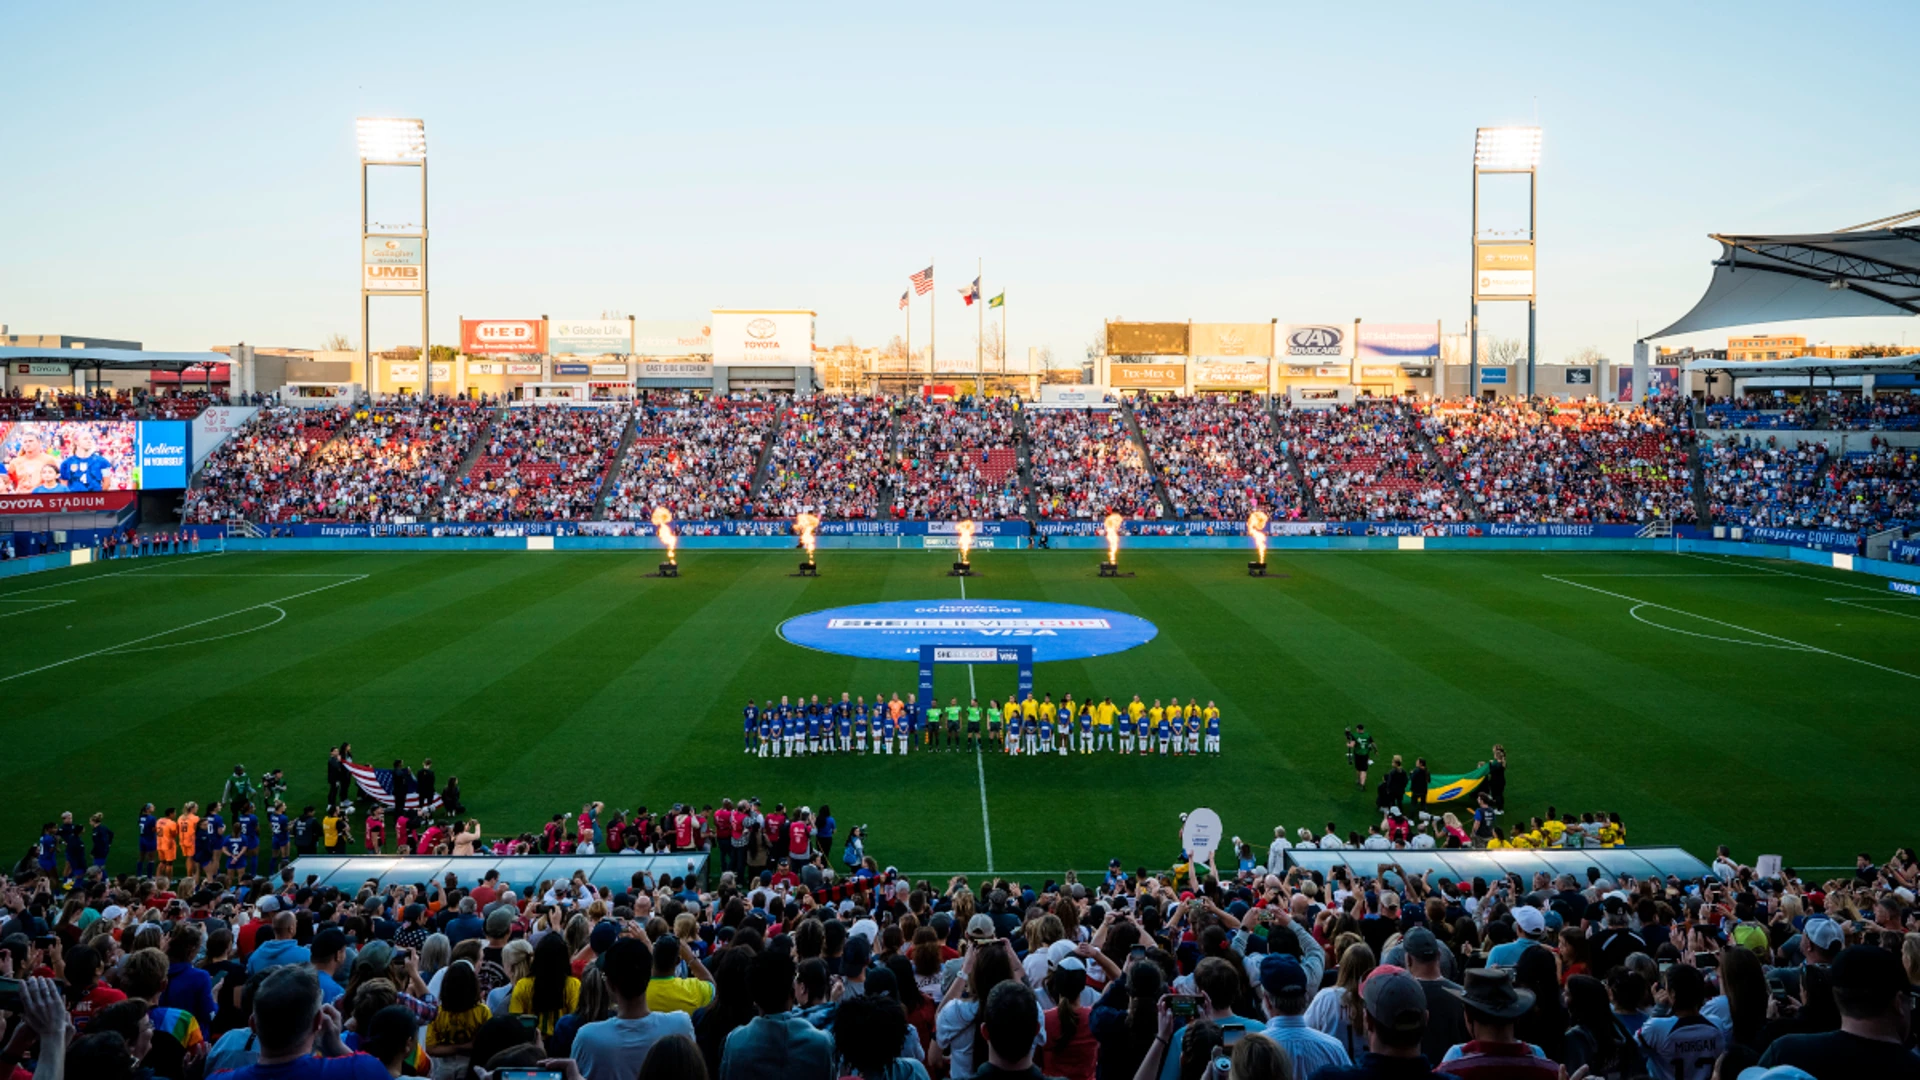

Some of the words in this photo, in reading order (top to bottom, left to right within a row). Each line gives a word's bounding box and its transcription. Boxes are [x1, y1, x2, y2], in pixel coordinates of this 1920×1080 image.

[372, 249, 414, 258] Gallagher
[367, 266, 419, 277] UMB
[572, 325, 602, 335] Globe
[604, 325, 623, 335] Life
[1166, 369, 1176, 380] Q
[144, 443, 184, 455] believe
[144, 458, 151, 466] IN
[152, 457, 184, 466] YOURSELF
[49, 497, 105, 508] STADIUM
[846, 522, 855, 532] IN
[1037, 521, 1074, 537] nspire
[1537, 524, 1547, 535] IN
[1549, 524, 1594, 535] YOURSELF
[1753, 527, 1805, 541] inspire
[1892, 582, 1917, 595] VISA
[999, 652, 1018, 661] VISA
[232, 843, 239, 855] 2
[1675, 1039, 1716, 1053] MORGAN
